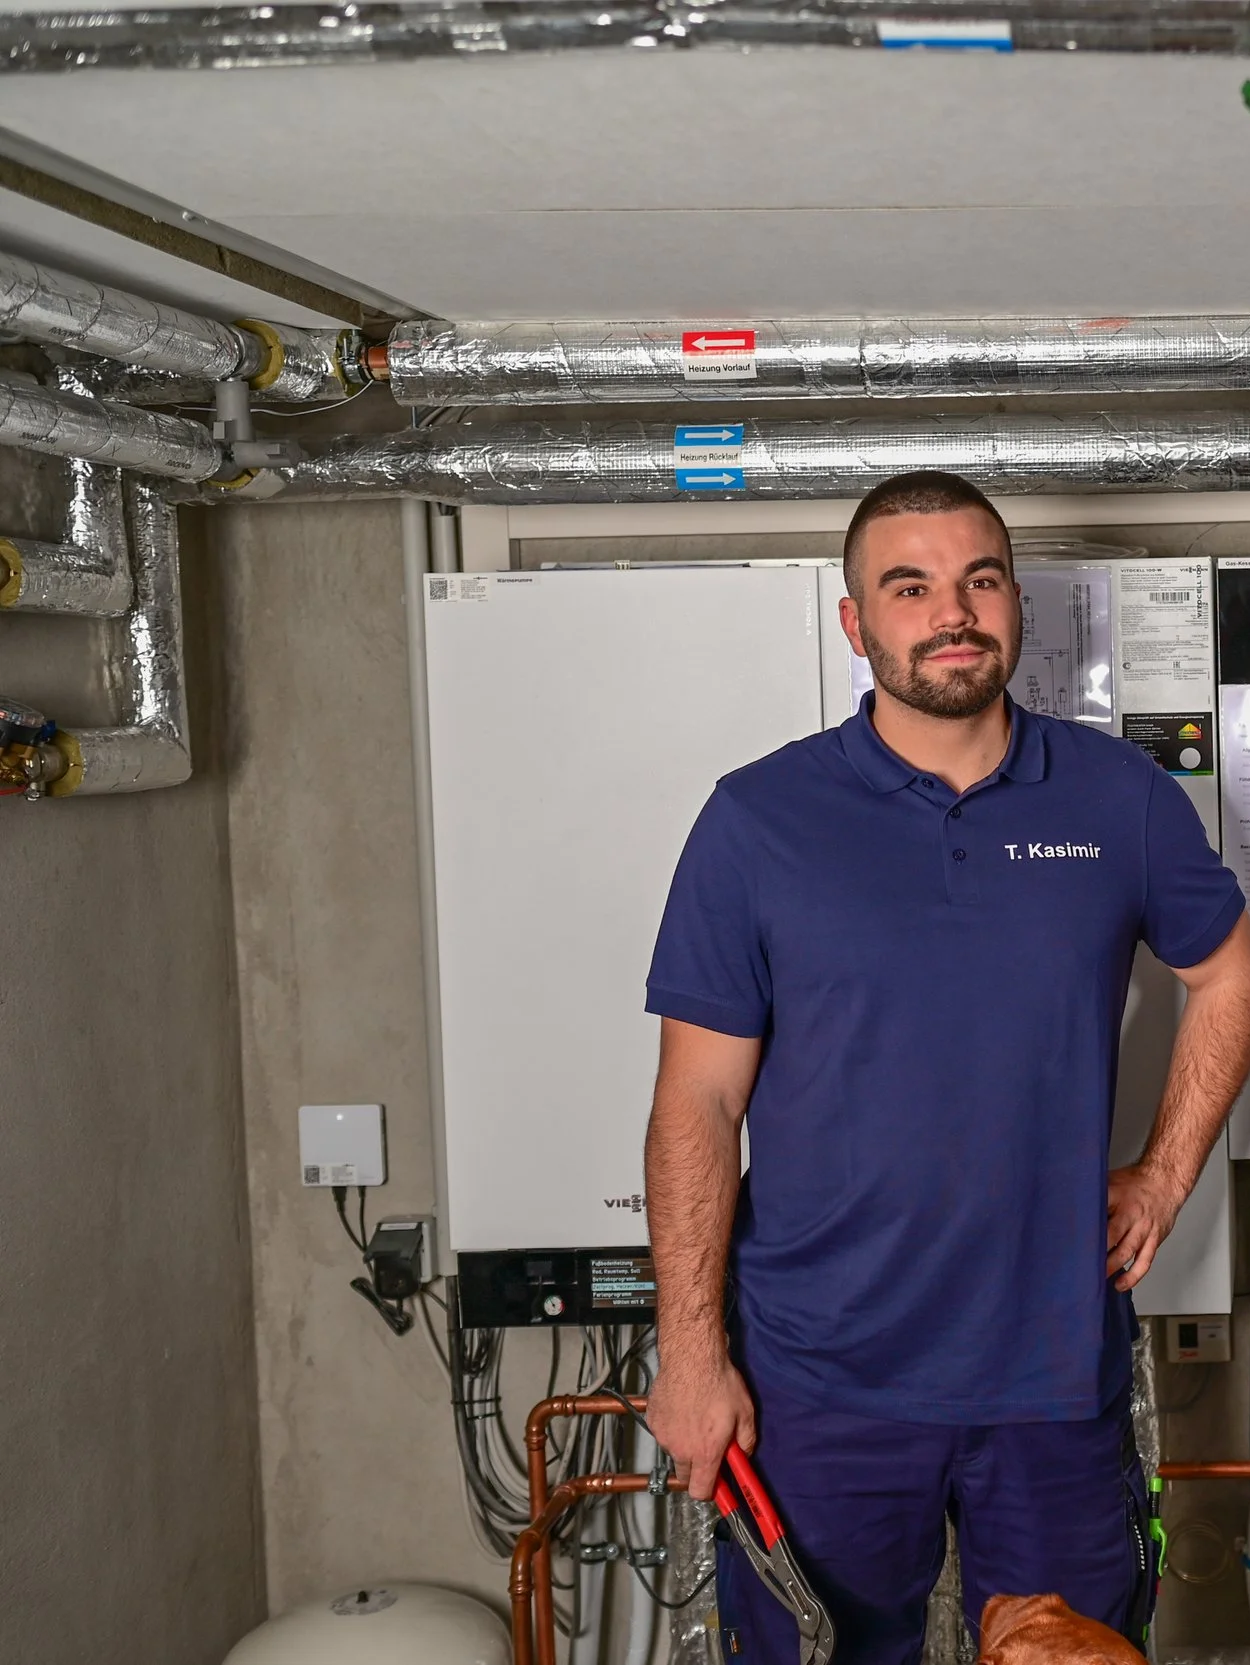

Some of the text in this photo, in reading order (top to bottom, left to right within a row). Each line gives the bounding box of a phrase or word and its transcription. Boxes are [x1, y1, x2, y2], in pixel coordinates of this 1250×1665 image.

[688, 362, 751, 374] Heizung Vorlauf
[680, 452, 739, 463] Heizung Rücklauf
[1004, 842, 1102, 860] T. Kasimir
